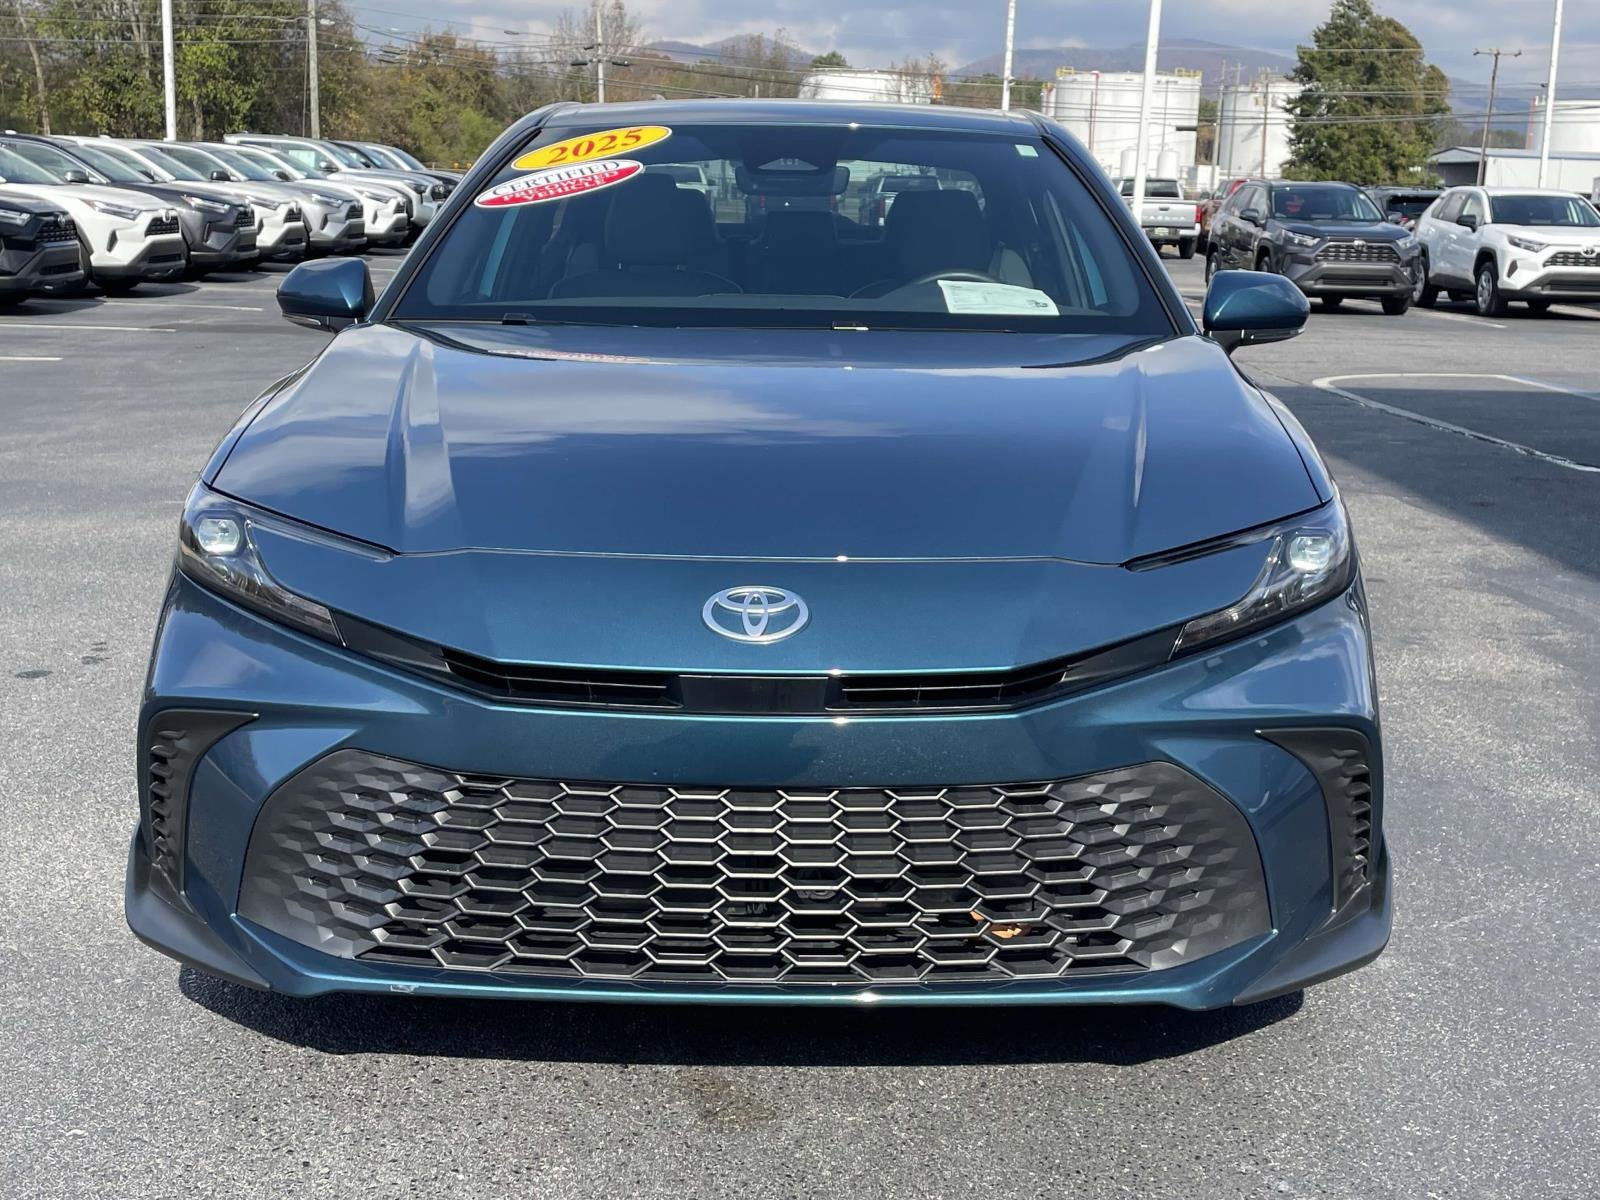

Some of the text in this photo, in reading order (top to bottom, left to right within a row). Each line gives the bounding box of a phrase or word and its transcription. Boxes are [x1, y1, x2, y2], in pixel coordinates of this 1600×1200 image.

[547, 128, 643, 165] 2025
[494, 161, 620, 196] CERTIFIED
[524, 177, 606, 200] VEHICLE
